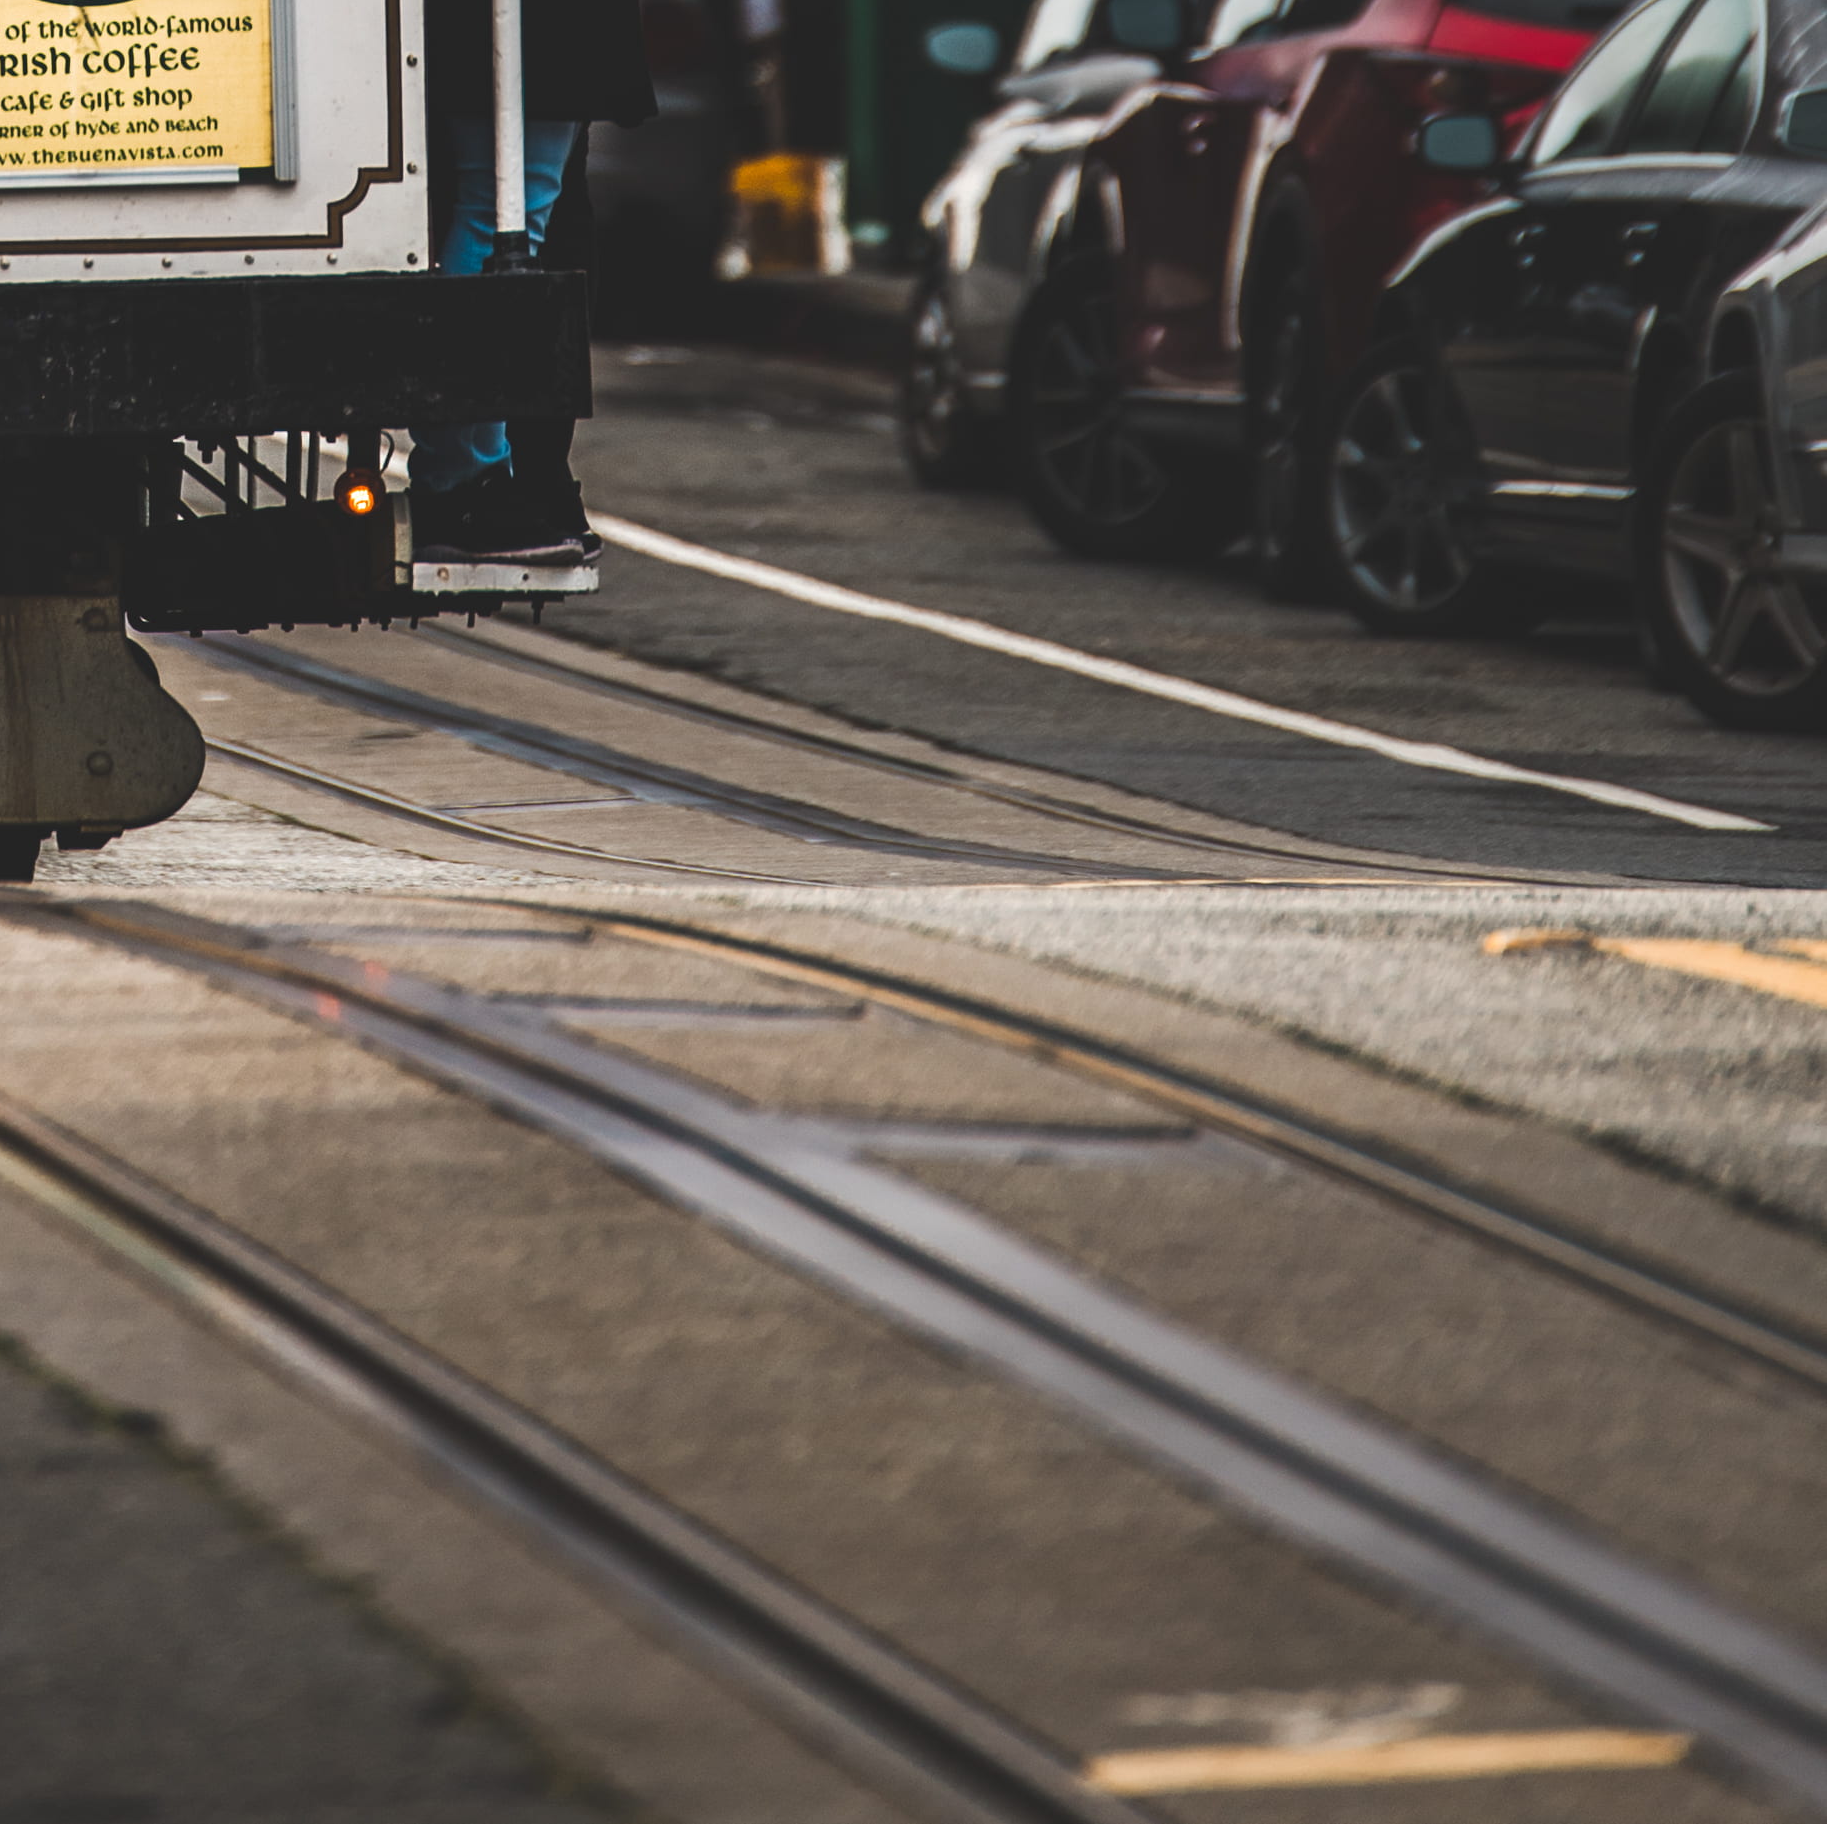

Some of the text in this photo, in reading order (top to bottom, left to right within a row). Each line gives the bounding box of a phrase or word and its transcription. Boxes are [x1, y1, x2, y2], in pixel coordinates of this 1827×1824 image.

[5, 23, 30, 43] of
[38, 19, 78, 39] the
[1, 87, 192, 114] cafe & gift shop
[50, 122, 70, 139] of
[75, 119, 120, 139] hyde
[126, 118, 160, 134] and
[166, 116, 218, 133] beach
